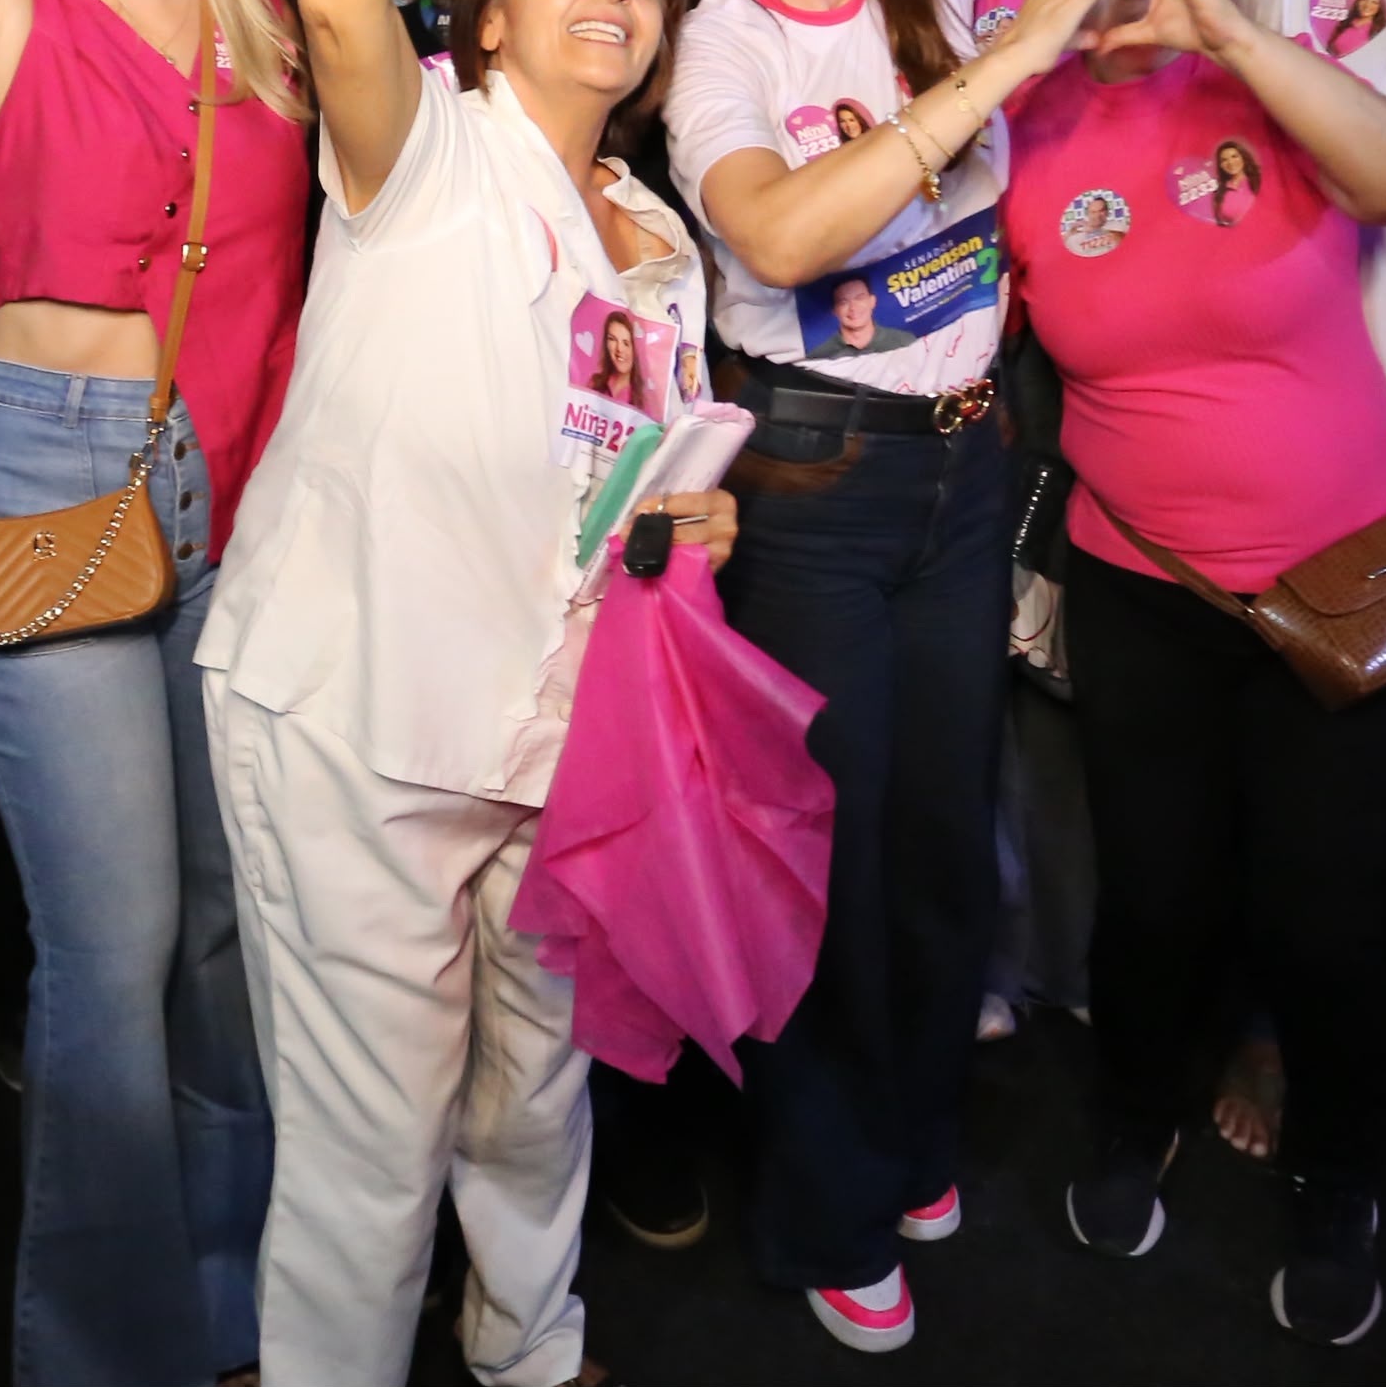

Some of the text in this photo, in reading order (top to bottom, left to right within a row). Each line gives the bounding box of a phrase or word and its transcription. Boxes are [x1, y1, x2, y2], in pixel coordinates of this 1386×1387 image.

[887, 236, 983, 293] Styvenson
[893, 257, 977, 308] Valentim
[564, 402, 608, 438] Nina
